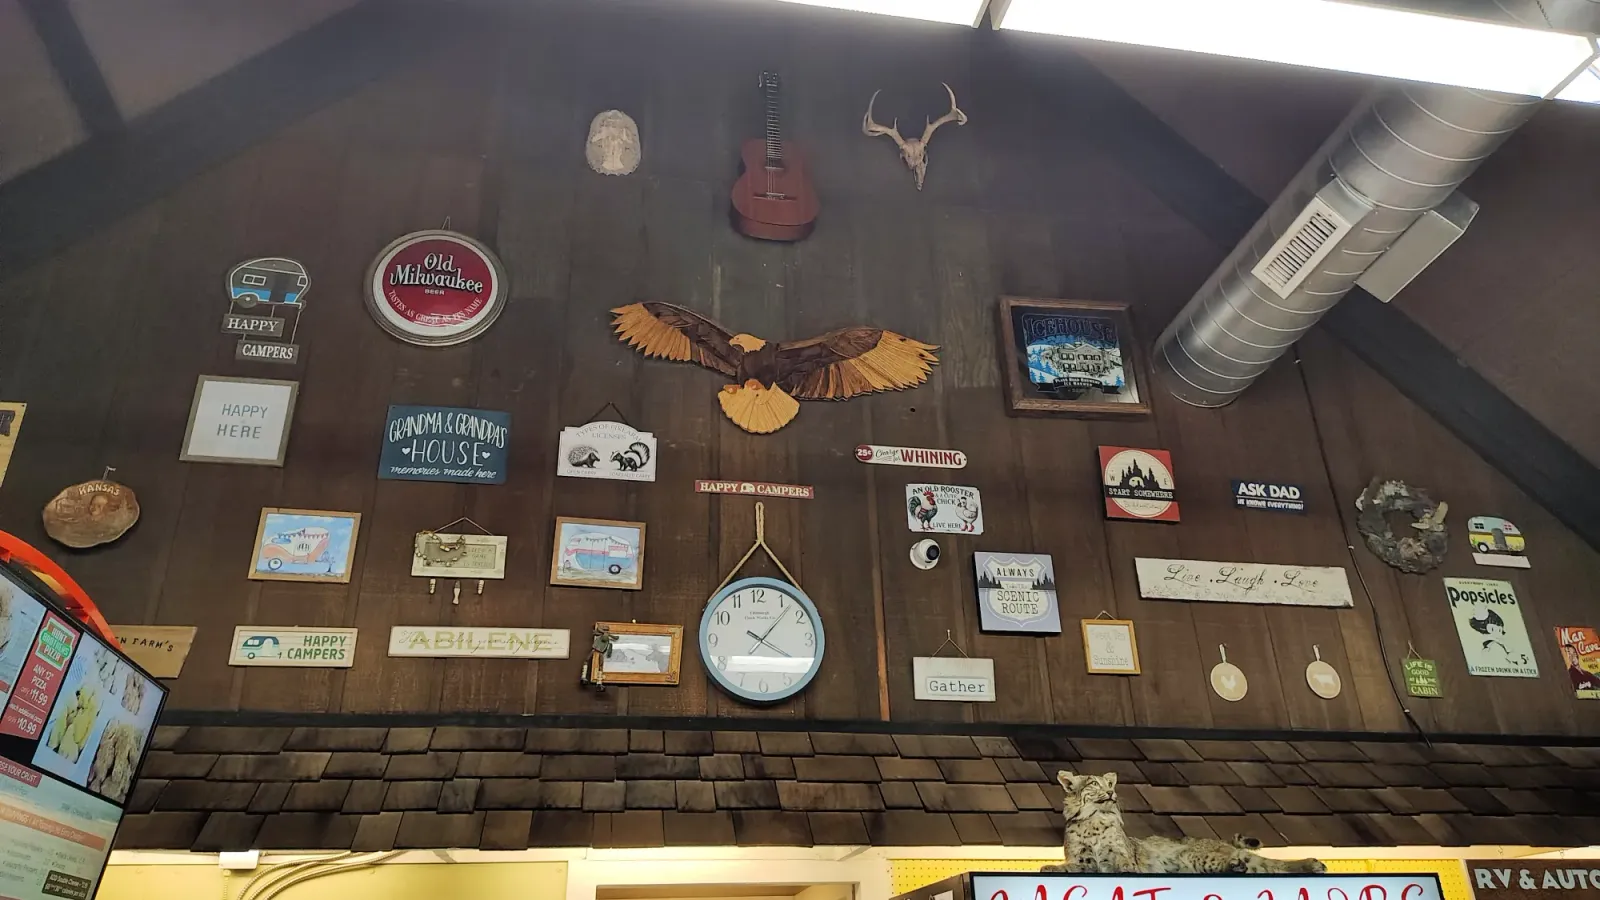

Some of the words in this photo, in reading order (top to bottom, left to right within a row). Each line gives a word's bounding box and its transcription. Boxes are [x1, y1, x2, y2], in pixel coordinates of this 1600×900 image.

[424, 252, 456, 272] Old
[390, 264, 483, 293] Milwaukee
[388, 289, 406, 311] TASTES
[405, 308, 415, 318] AS
[465, 297, 482, 315] NAME
[227, 317, 279, 332] HAPPY
[1025, 317, 1114, 340] ICEHOUSE
[242, 343, 294, 360] CAMPERS
[222, 403, 269, 419] HAPPY
[216, 423, 262, 439] HERE
[389, 411, 442, 443] GRANDMA
[444, 412, 453, 434] &
[575, 425, 598, 438] TYPES
[411, 439, 485, 466] HOUSE
[900, 449, 962, 466] WHINING
[390, 466, 441, 476] memories
[443, 466, 474, 477] made
[474, 468, 497, 478] here
[78, 483, 121, 496] KANSAS
[700, 482, 738, 492] HAPPY
[757, 485, 810, 497] CAMPERS
[912, 487, 923, 495] AN
[940, 486, 974, 499] ROOSTER
[1108, 487, 1130, 496] START
[1134, 490, 1173, 499] SOMEWHERE
[1238, 482, 1267, 496] ASK
[1269, 485, 1300, 499] DAD
[937, 498, 957, 506] CHICK
[996, 567, 1035, 577] ALWAYS
[1164, 564, 1201, 582] Live
[1216, 566, 1268, 594] Laugh
[1281, 569, 1319, 588] Love
[732, 594, 741, 608] 11
[750, 588, 767, 603] 12
[778, 594, 784, 608] 1
[997, 590, 1040, 602] SCENIC
[1447, 586, 1516, 608] Popsicles
[1001, 603, 1039, 614] ROUTE
[715, 610, 730, 626] 10
[795, 609, 806, 624] 2
[303, 635, 347, 647] HAPPY
[408, 630, 553, 651] ABILENE
[708, 633, 718, 647] 9
[804, 632, 813, 647] 3
[1560, 627, 1586, 646] Man
[132, 638, 174, 652] FARM'S
[287, 648, 346, 660] CAMPERS
[33, 664, 46, 676] ANY
[717, 656, 728, 671] 8
[1405, 661, 1423, 670] LIFE
[31, 675, 48, 690] PIZZA
[737, 672, 746, 687] 7
[758, 679, 769, 693] 6
[782, 672, 792, 686] 5
[929, 680, 986, 693] Gather
[1410, 686, 1438, 695] CABIN
[21, 769, 38, 780] CRUST
[1474, 868, 1511, 889] RV
[1519, 868, 1538, 890] &
[1542, 868, 1600, 889] AUTO
